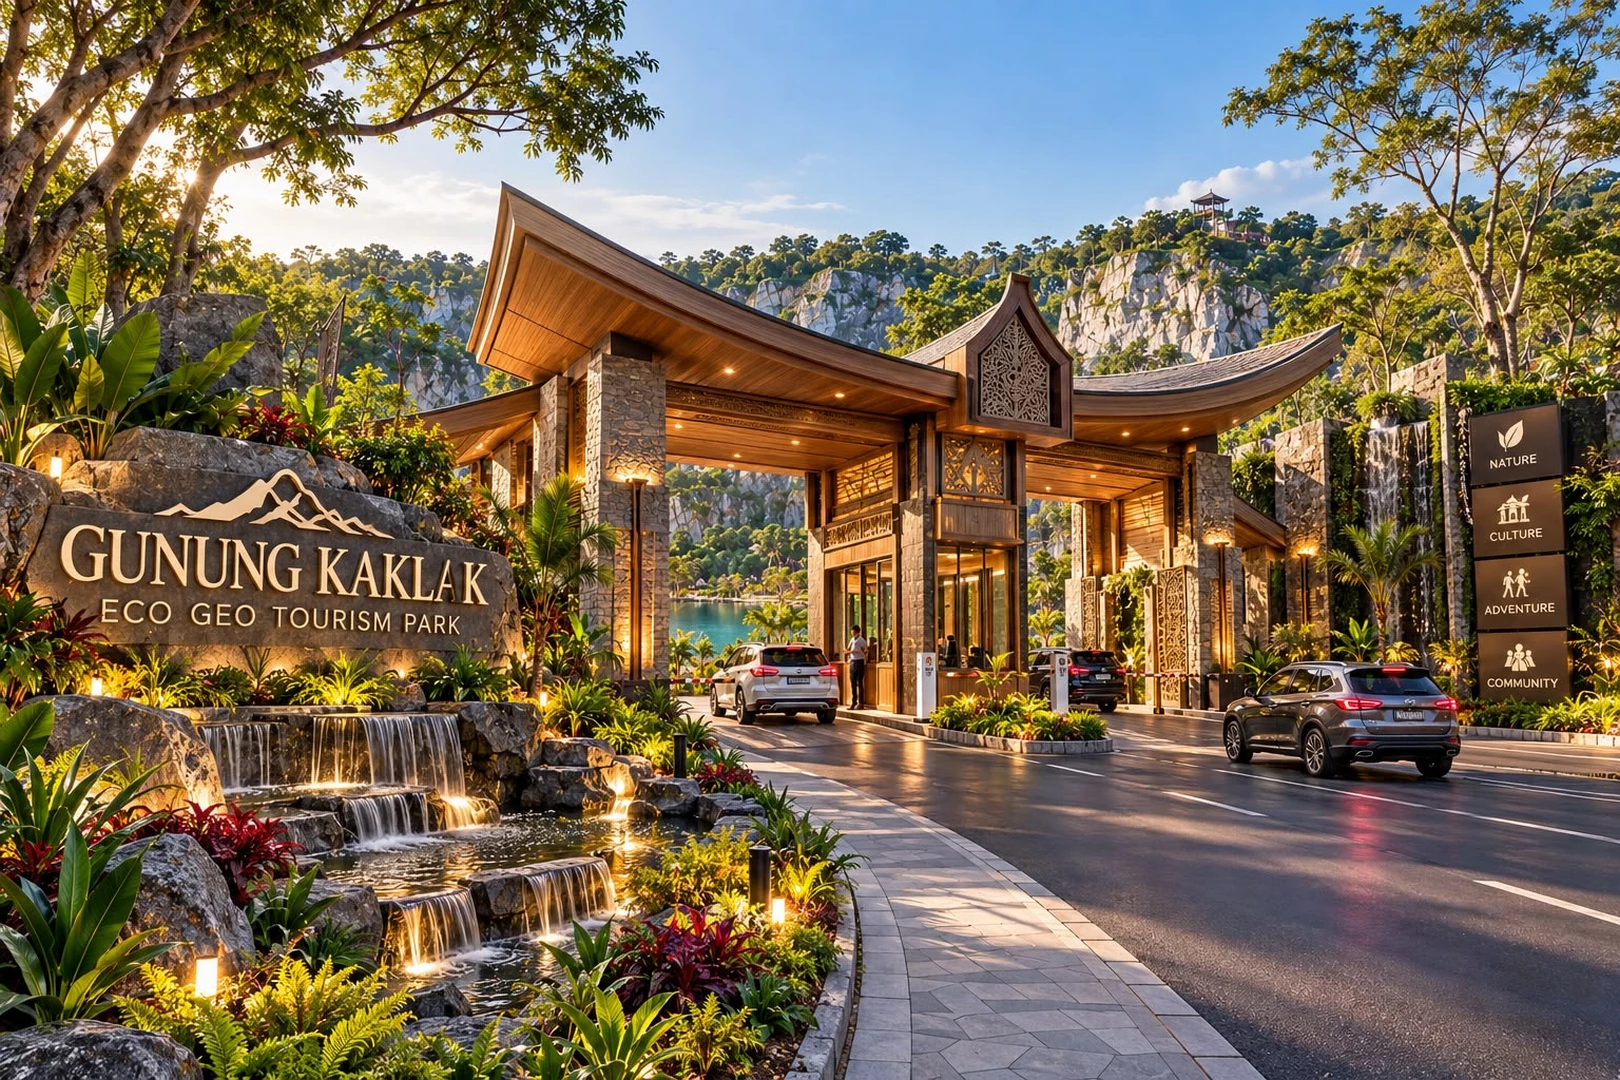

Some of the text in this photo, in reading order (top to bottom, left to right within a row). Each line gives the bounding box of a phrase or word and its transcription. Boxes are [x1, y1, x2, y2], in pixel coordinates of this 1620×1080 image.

[1489, 454, 1537, 469] NATURE
[1489, 528, 1543, 542] CULTURE
[60, 524, 489, 606] GUNUNG KAKLAK
[1484, 603, 1555, 616] ADVENTURE
[101, 599, 460, 636] ECO GEO TOURISM PARK
[1486, 678, 1558, 690] COMMUNITY
